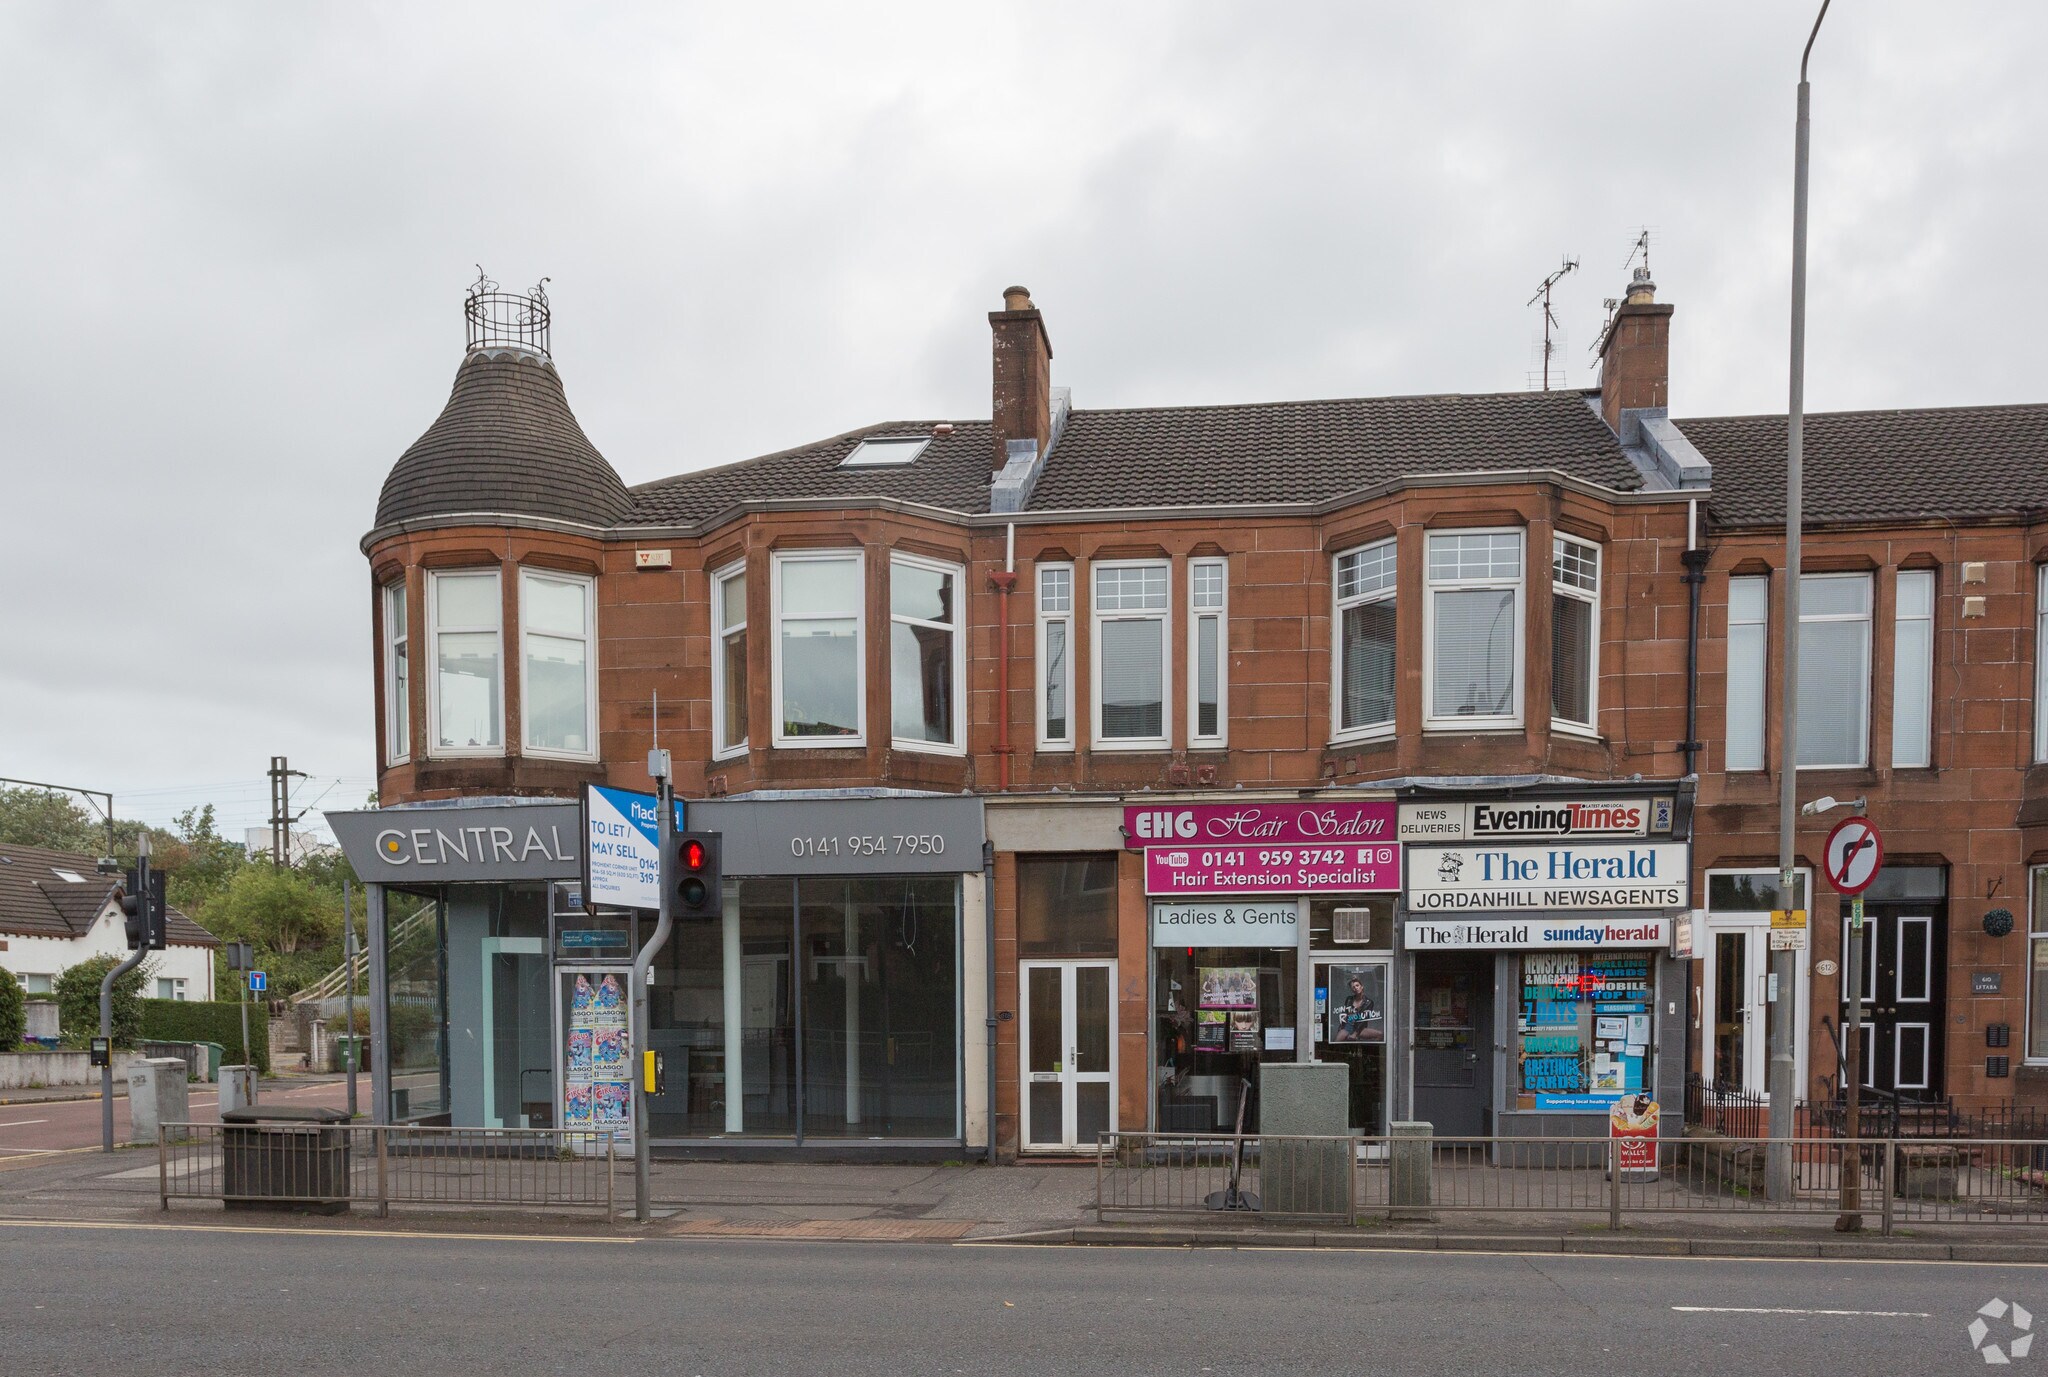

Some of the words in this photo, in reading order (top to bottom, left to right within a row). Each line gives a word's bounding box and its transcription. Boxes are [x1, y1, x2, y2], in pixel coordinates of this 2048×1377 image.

[1135, 811, 1198, 838] EHG
[1206, 809, 1288, 838] Hair
[1297, 809, 1386, 837] Salon
[1416, 810, 1447, 820] NEWS
[591, 820, 606, 834] TO
[608, 823, 625, 837] LET
[1401, 823, 1461, 834] DELIVERIES
[375, 825, 575, 865] CENTRAL
[592, 841, 614, 856] MAY
[616, 844, 638, 859] SELL
[791, 837, 839, 857] 0141
[848, 836, 887, 856] 954
[893, 834, 945, 855] 7950
[639, 858, 659, 870] 0141
[1202, 852, 1246, 867] 0141
[1259, 850, 1294, 866] 959
[1299, 849, 1345, 865] 3742
[1475, 852, 1539, 881] The
[1547, 849, 1658, 880] Herald
[639, 871, 654, 883] 319
[1172, 871, 1209, 887] Hair
[1213, 870, 1292, 886] Extension
[1297, 869, 1377, 888] Specialist
[1416, 892, 1538, 908] JORDANHILL
[1543, 889, 1680, 906] NEWSAGENTS
[1158, 909, 1217, 925] Ladies
[1224, 909, 1236, 925] &
[1242, 908, 1297, 925] Gents
[1416, 926, 1451, 944] The
[1466, 926, 1529, 944] Herald
[1524, 954, 1579, 974] NEWSPAPER
[1592, 960, 1647, 968] CALLING
[1593, 968, 1647, 977] CARDS
[1525, 975, 1534, 984] &
[1533, 974, 1579, 985] MAGAZINE
[1592, 982, 1647, 991] MOBILE
[1524, 986, 1578, 1000] DELIVERY
[1593, 991, 1624, 999] TOP
[1626, 991, 1647, 999] UP
[1524, 1001, 1533, 1023] 7
[1536, 1001, 1578, 1023] DAYS
[1524, 1036, 1579, 1052] GROCERIES
[1524, 1058, 1579, 1076] GREETINGS
[1525, 1076, 1580, 1090] CARDS
[595, 1085, 620, 1099] CIRCUS
